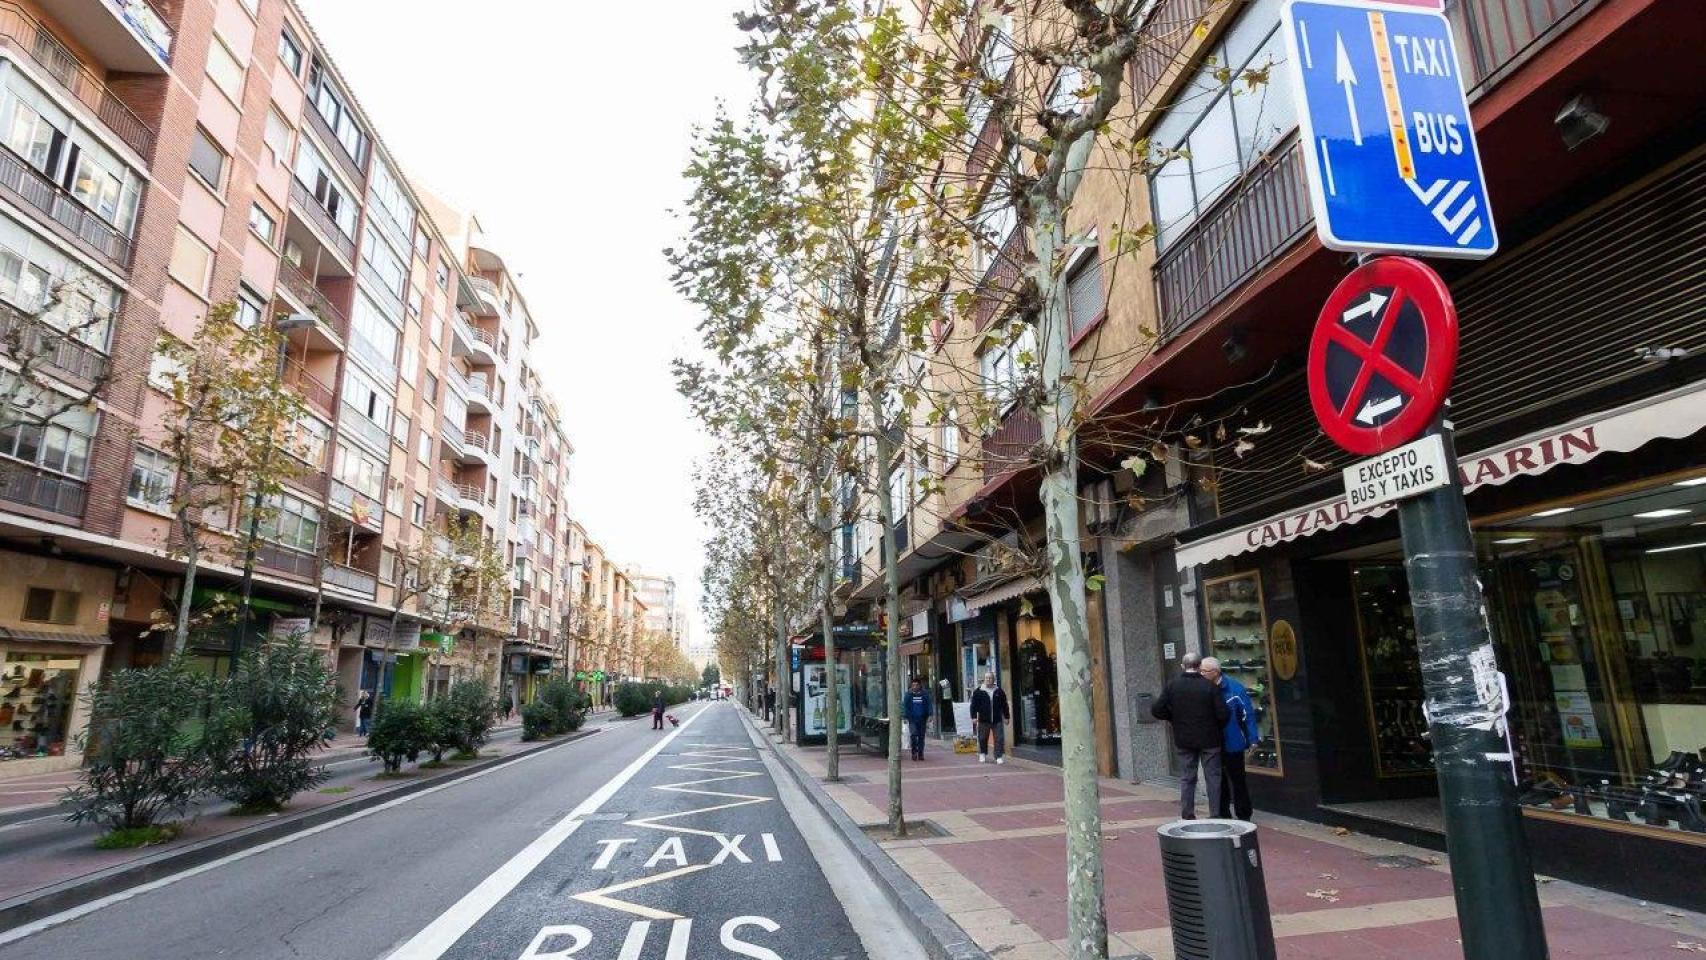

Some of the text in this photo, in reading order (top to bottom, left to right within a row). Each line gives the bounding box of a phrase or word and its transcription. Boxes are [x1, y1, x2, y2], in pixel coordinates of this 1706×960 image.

[1394, 35, 1451, 77] TAXI
[1413, 111, 1463, 156] BUS
[1351, 465, 1434, 505] BUS Y TAXIS
[1359, 450, 1418, 483] EXCEPTO
[1246, 498, 1398, 547] CALZAD
[591, 832, 782, 870] TAXI
